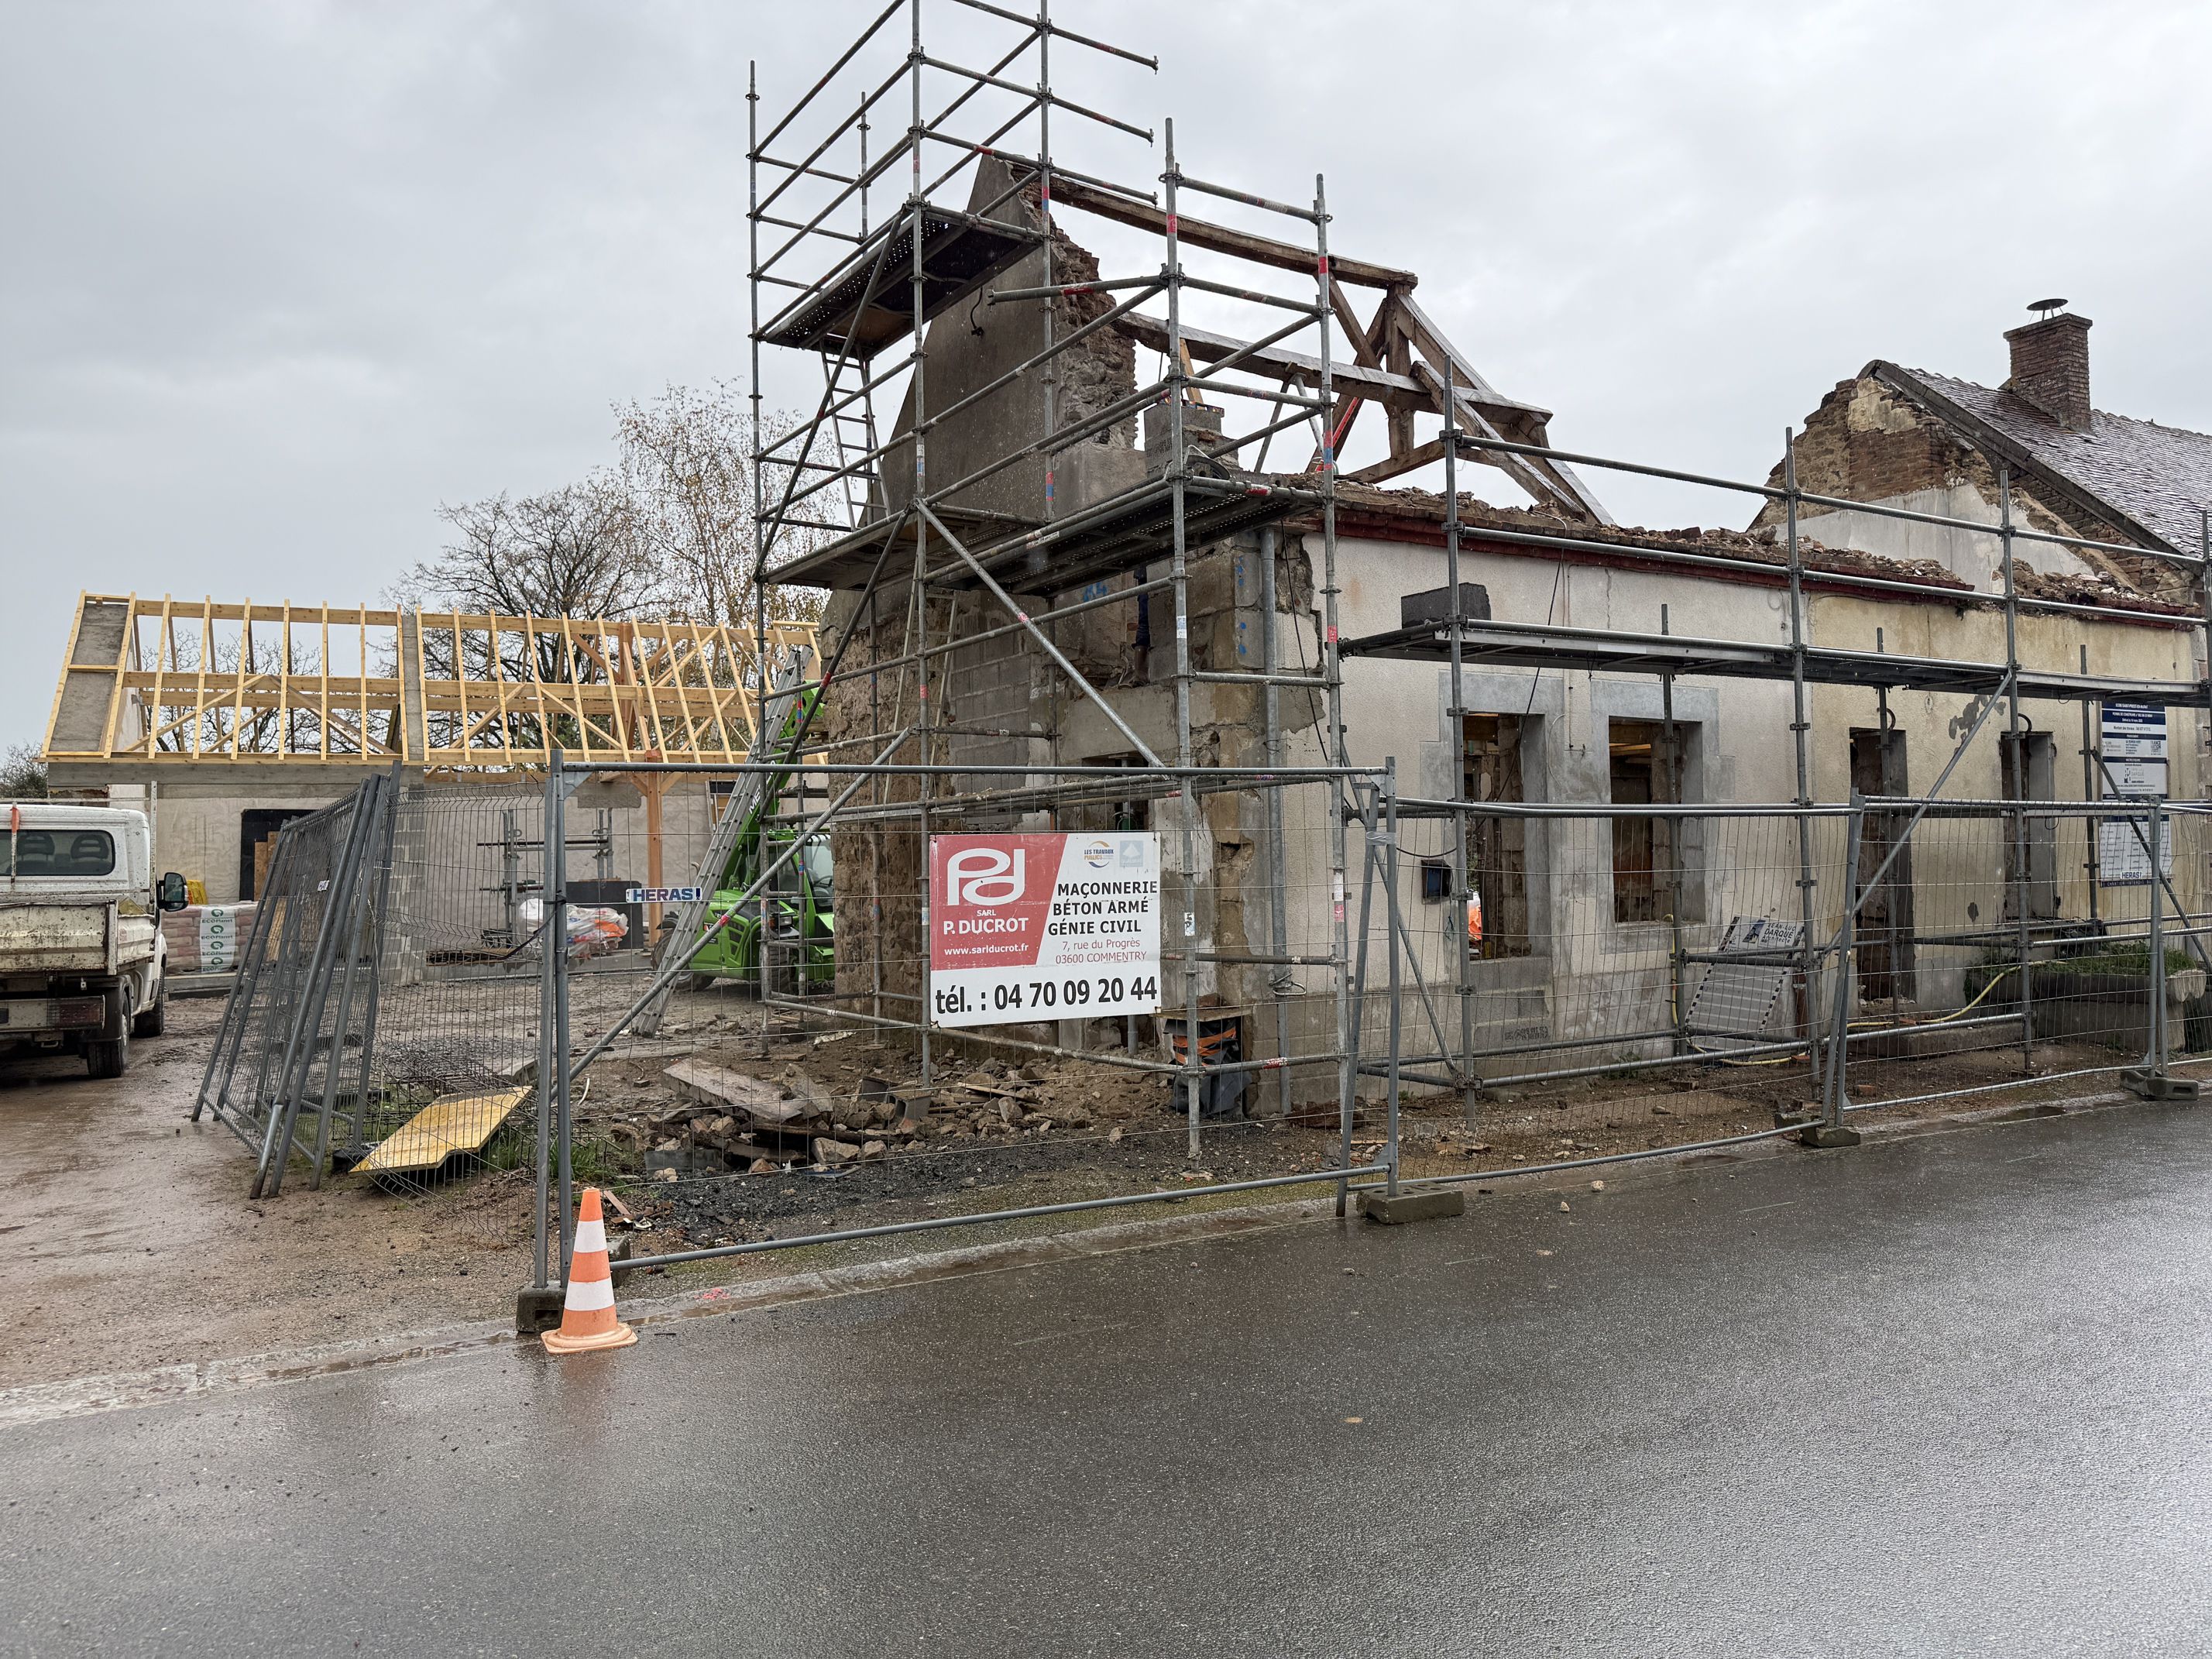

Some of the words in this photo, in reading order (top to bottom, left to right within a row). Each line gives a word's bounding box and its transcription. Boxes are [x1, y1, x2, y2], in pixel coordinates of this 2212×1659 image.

[1058, 881, 1157, 898] MAÇONNERIE
[1053, 898, 1102, 915] BÉTON
[1108, 896, 1149, 914] ARMÉ
[943, 920, 956, 935] P.
[959, 917, 1029, 934] DUCROT
[1048, 919, 1094, 936] GÉNIE
[1100, 919, 1142, 933] CIVIL
[1765, 929, 1794, 939] DARQUE
[944, 943, 1029, 955] www.sarlducrot.fr
[1062, 941, 1070, 952] 7,
[1091, 939, 1103, 949] du
[1106, 937, 1140, 950] Progrès
[1056, 953, 1084, 964] 03600
[1087, 951, 1147, 963] COMMENTRY
[936, 984, 972, 1014] tél.
[994, 984, 1022, 1010] 04
[1029, 981, 1056, 1008] 70
[1063, 979, 1090, 1005] 09
[1097, 977, 1123, 1003] 20
[1131, 976, 1157, 1001] 44
